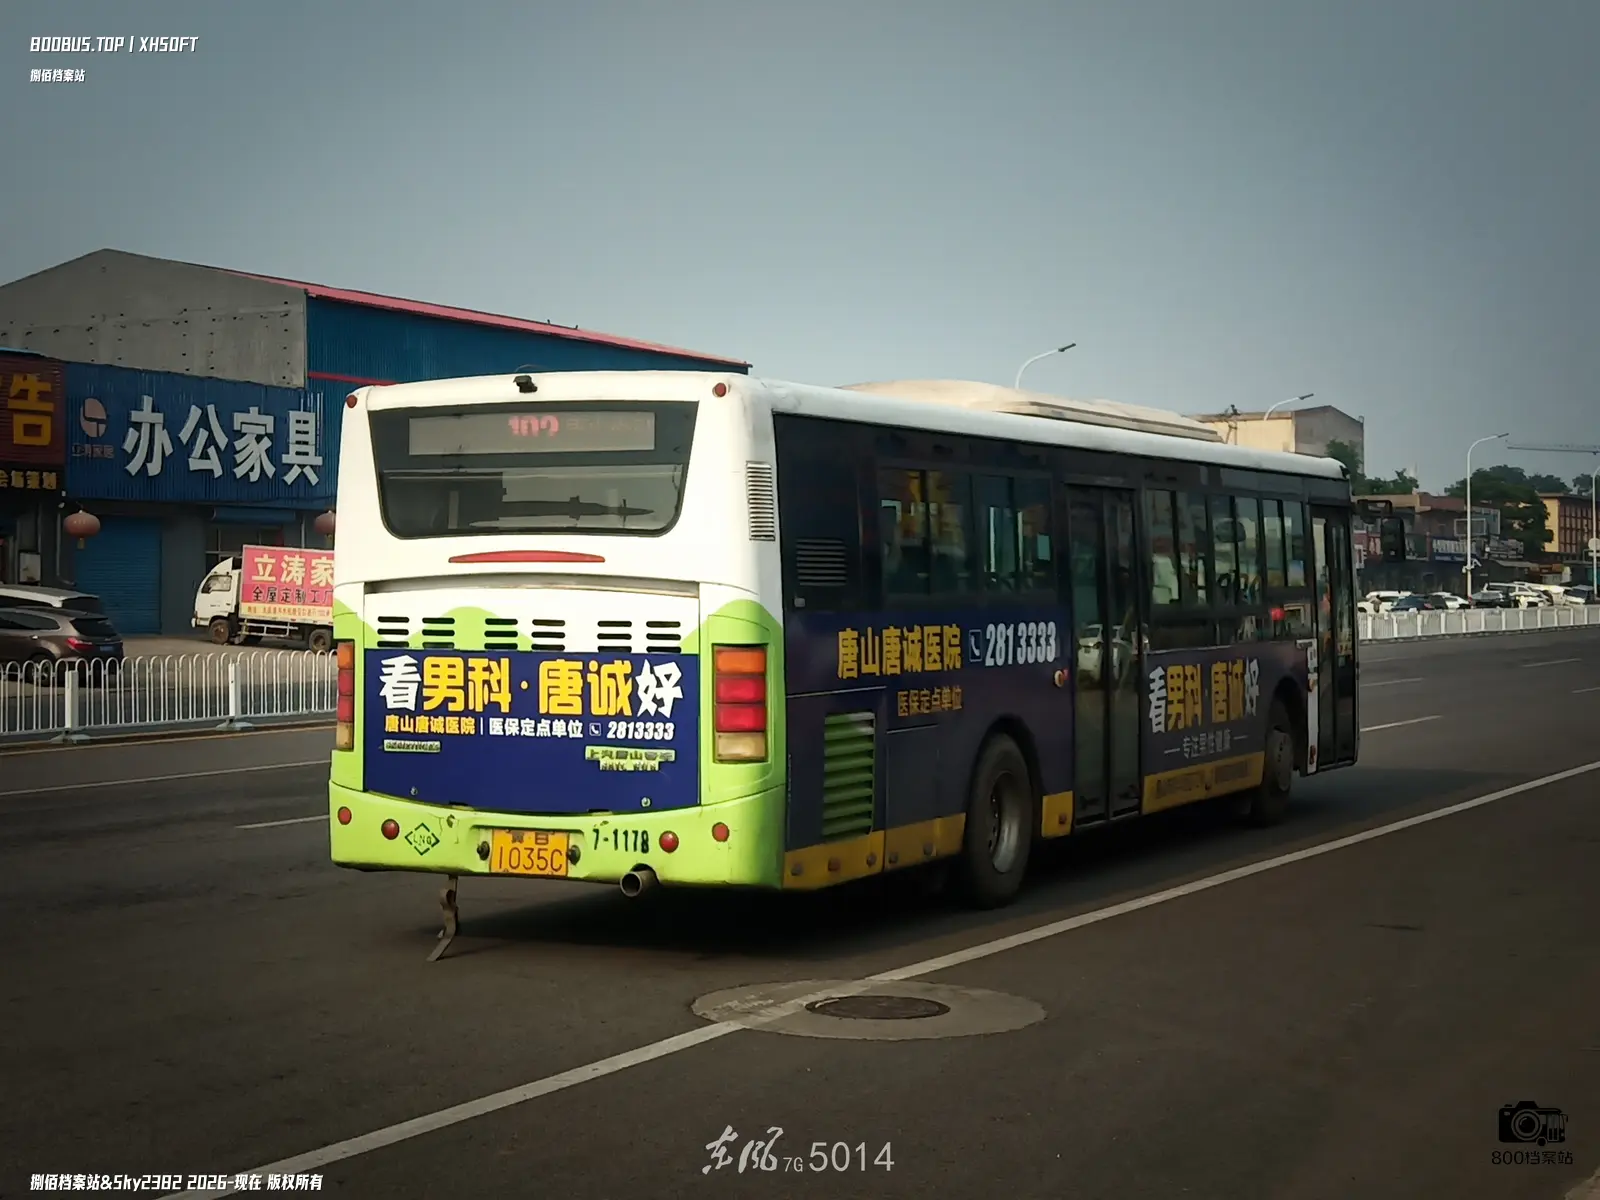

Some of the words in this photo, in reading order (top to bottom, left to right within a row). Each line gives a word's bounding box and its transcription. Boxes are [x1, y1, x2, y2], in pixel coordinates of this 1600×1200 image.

[0, 373, 55, 447] 告
[122, 395, 324, 487] 办公家具
[251, 553, 334, 588] 立涛家
[836, 623, 963, 680] 唐山唐诚医院
[379, 654, 684, 718] 看男科·唐诚好
[384, 715, 476, 736] 唐山唐诚医院
[489, 717, 584, 740] 医保定点单位
[606, 721, 676, 741] 2813333
[498, 845, 563, 873] 1035C
[593, 828, 650, 854] 7-1178
